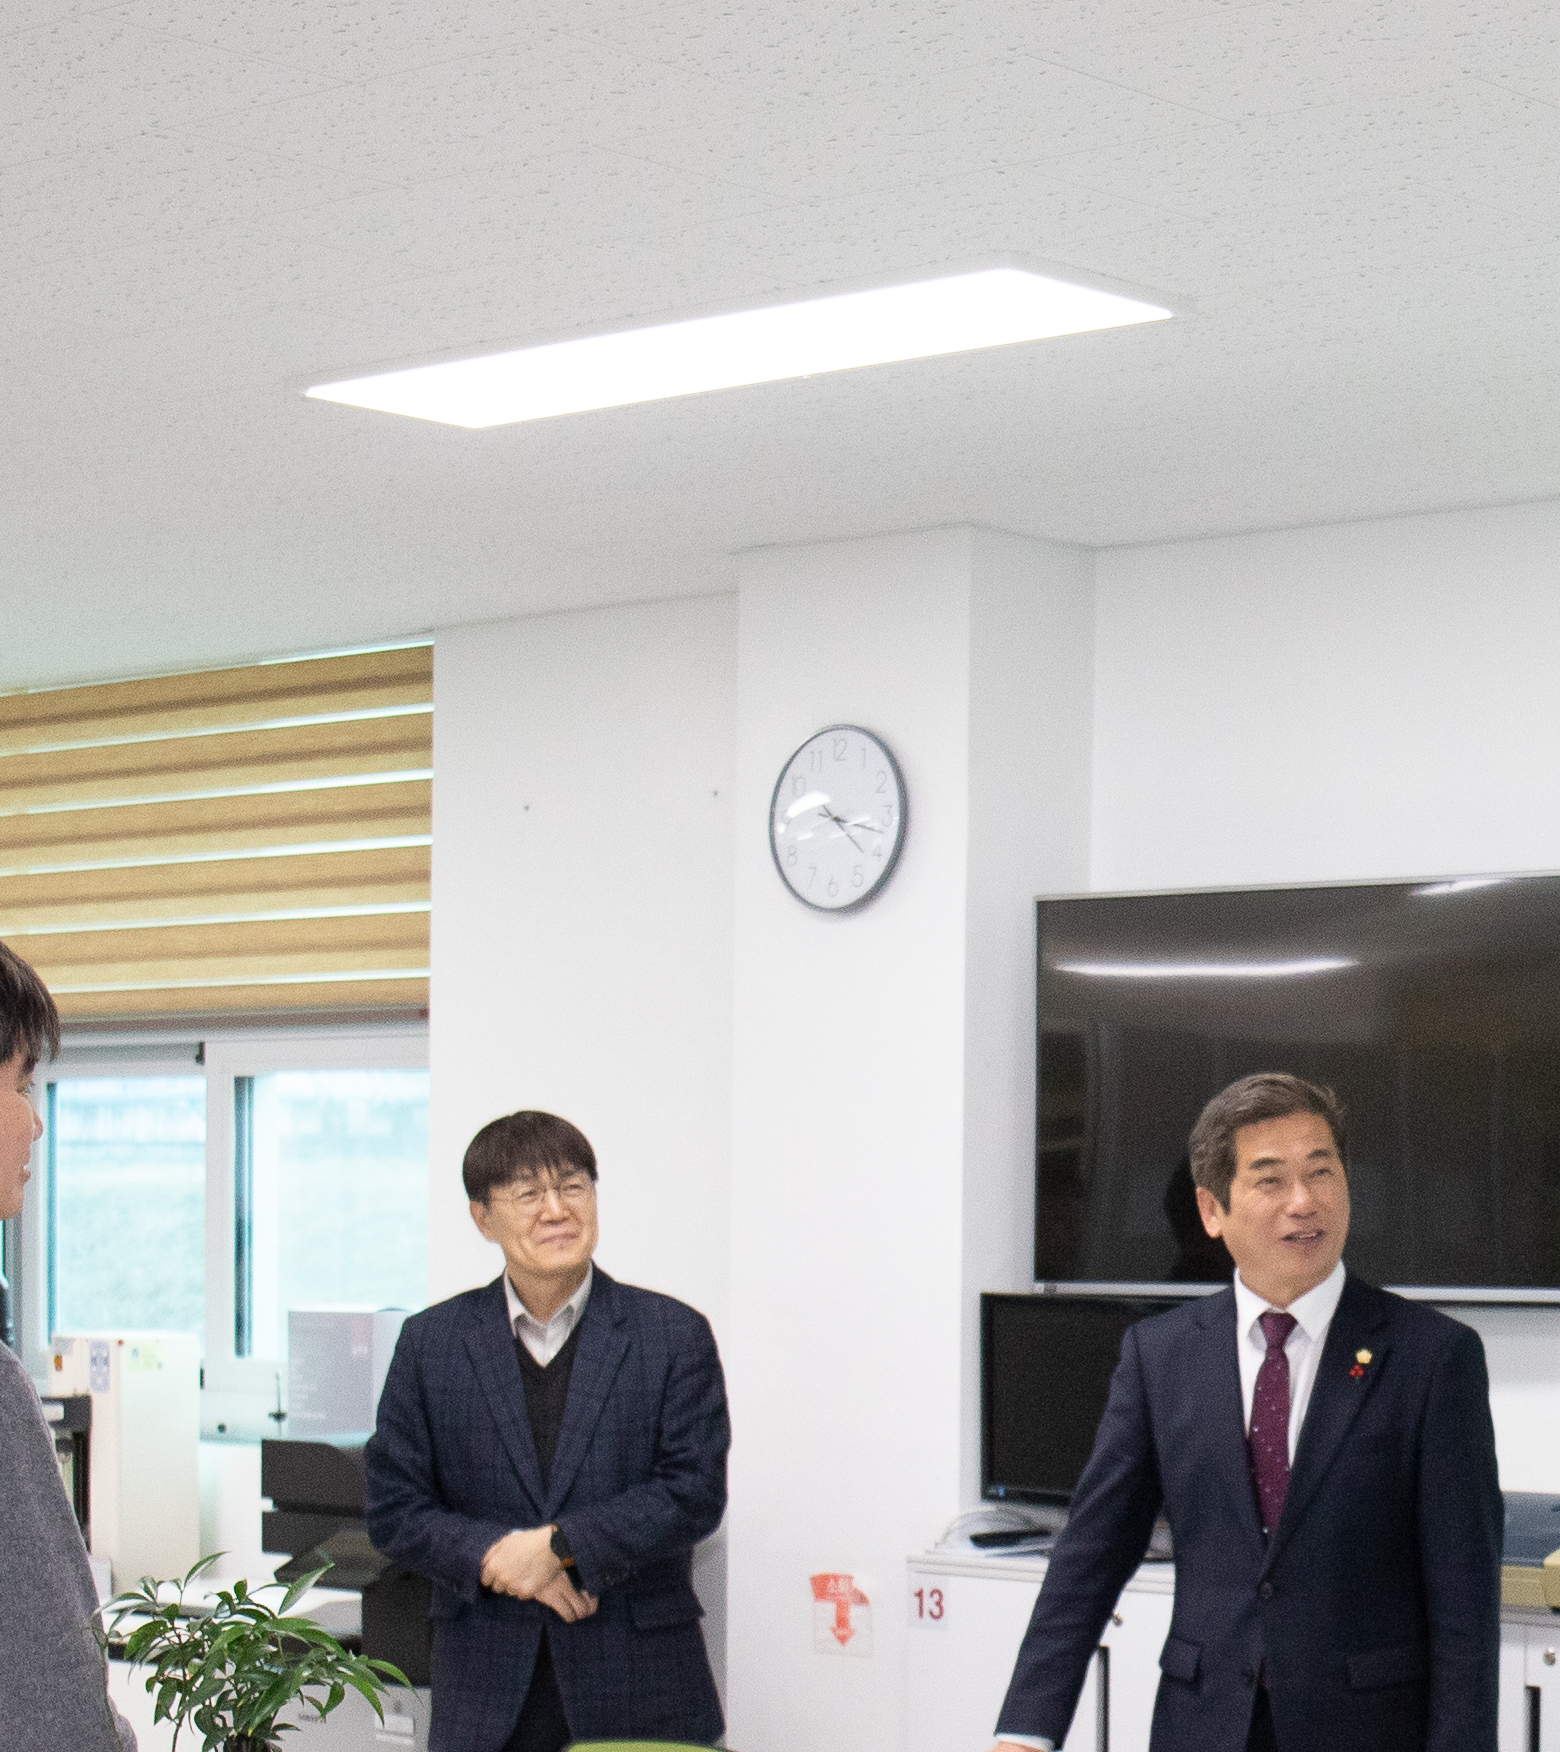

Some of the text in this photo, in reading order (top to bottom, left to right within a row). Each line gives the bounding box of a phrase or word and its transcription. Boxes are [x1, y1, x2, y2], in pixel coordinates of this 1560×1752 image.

[809, 750, 823, 772] 11
[832, 738, 847, 762] 12
[792, 776, 806, 797] 10
[876, 771, 887, 794] 2
[882, 805, 893, 827] 3
[787, 846, 797, 866] 8
[872, 846, 882, 861] 4
[808, 866, 817, 889] 7
[851, 864, 864, 887] 5
[827, 877, 838, 897] 6
[914, 1587, 944, 1620] 13
